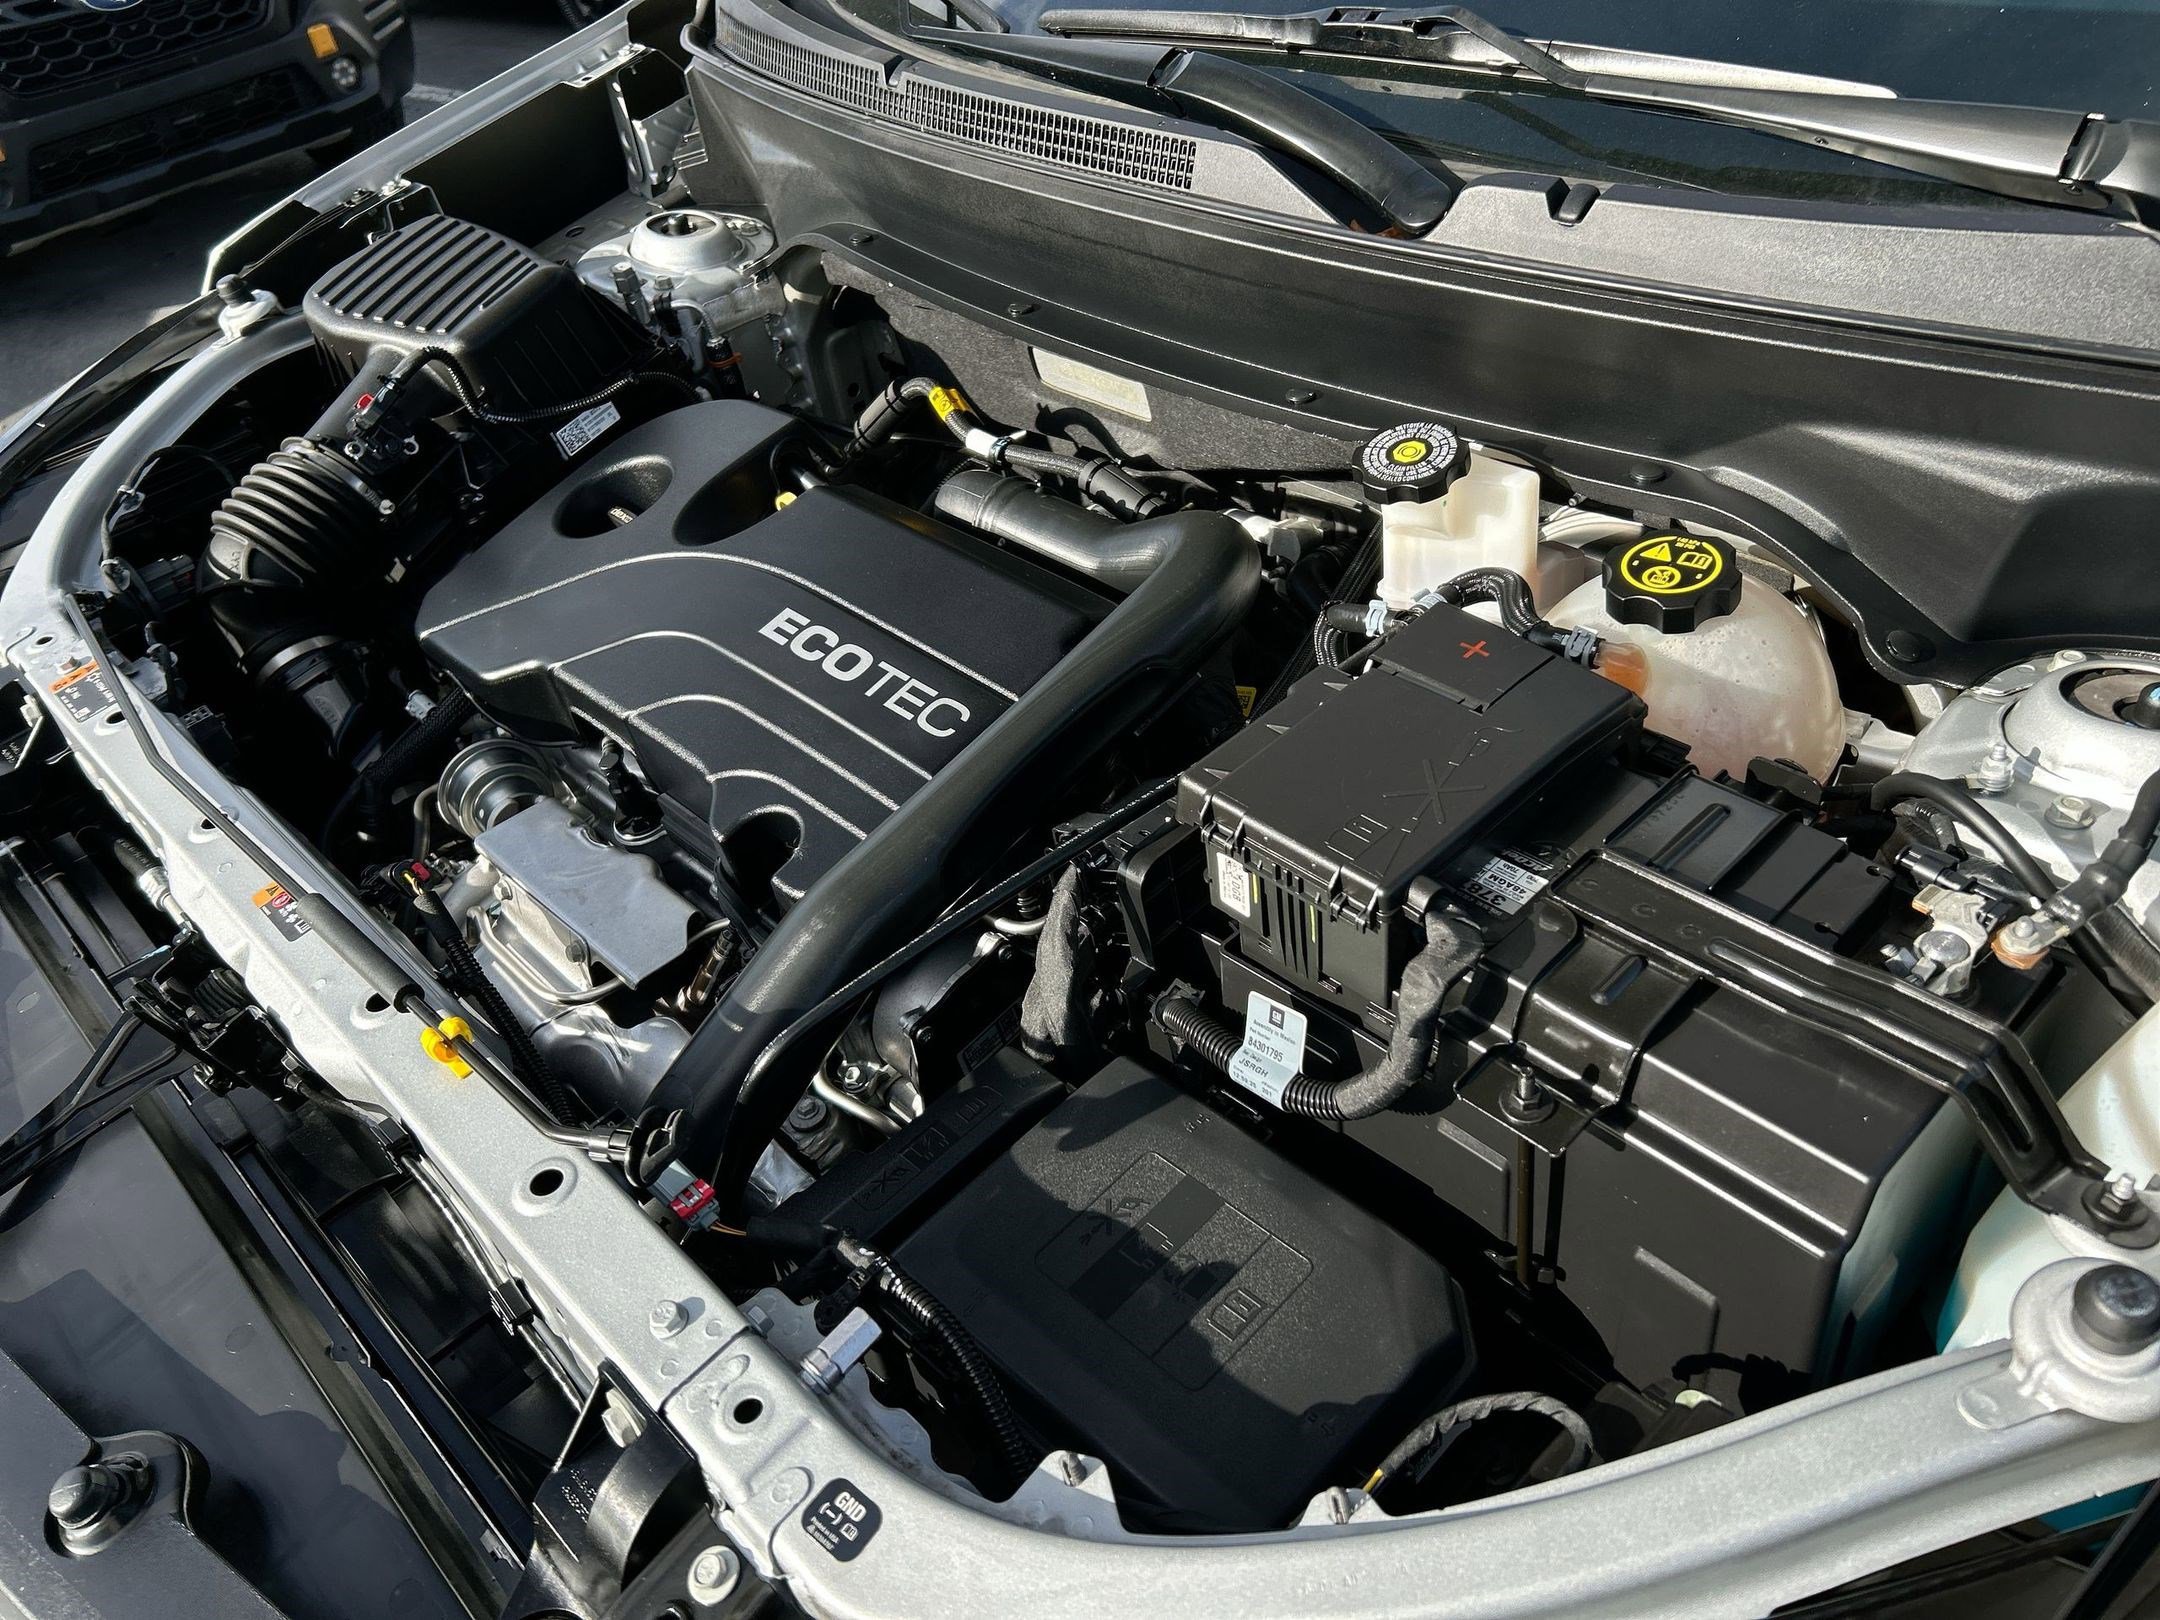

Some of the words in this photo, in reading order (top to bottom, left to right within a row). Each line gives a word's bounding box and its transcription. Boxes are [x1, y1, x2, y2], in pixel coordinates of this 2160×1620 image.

[758, 607, 971, 737] ECOTEC
[1248, 1036, 1283, 1062] 84301795
[834, 1491, 867, 1522] GND
